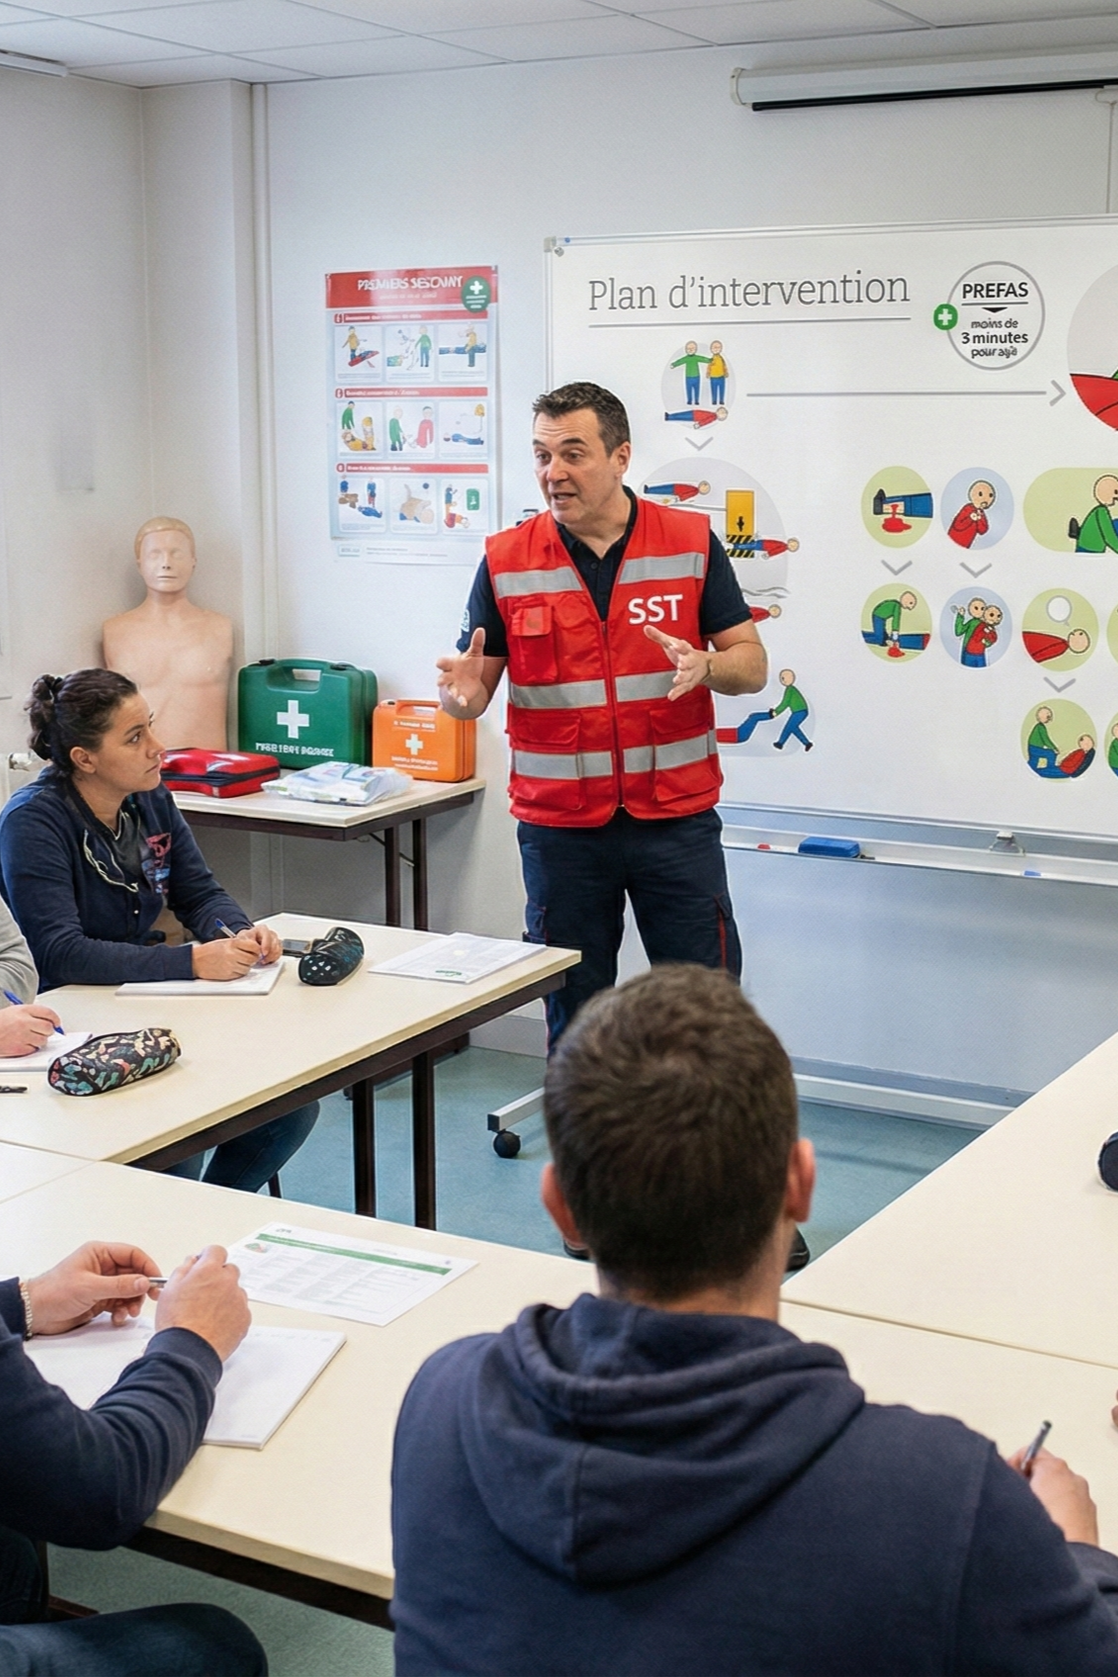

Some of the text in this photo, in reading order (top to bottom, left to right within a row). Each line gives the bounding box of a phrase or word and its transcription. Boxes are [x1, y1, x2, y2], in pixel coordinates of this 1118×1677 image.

[588, 269, 911, 310] Plan d'intervention
[962, 281, 1029, 299] PREFAS
[971, 317, 1019, 329] moins de
[961, 331, 1029, 344] 3 minutes
[971, 348, 997, 359] pour
[628, 594, 684, 625] SST
